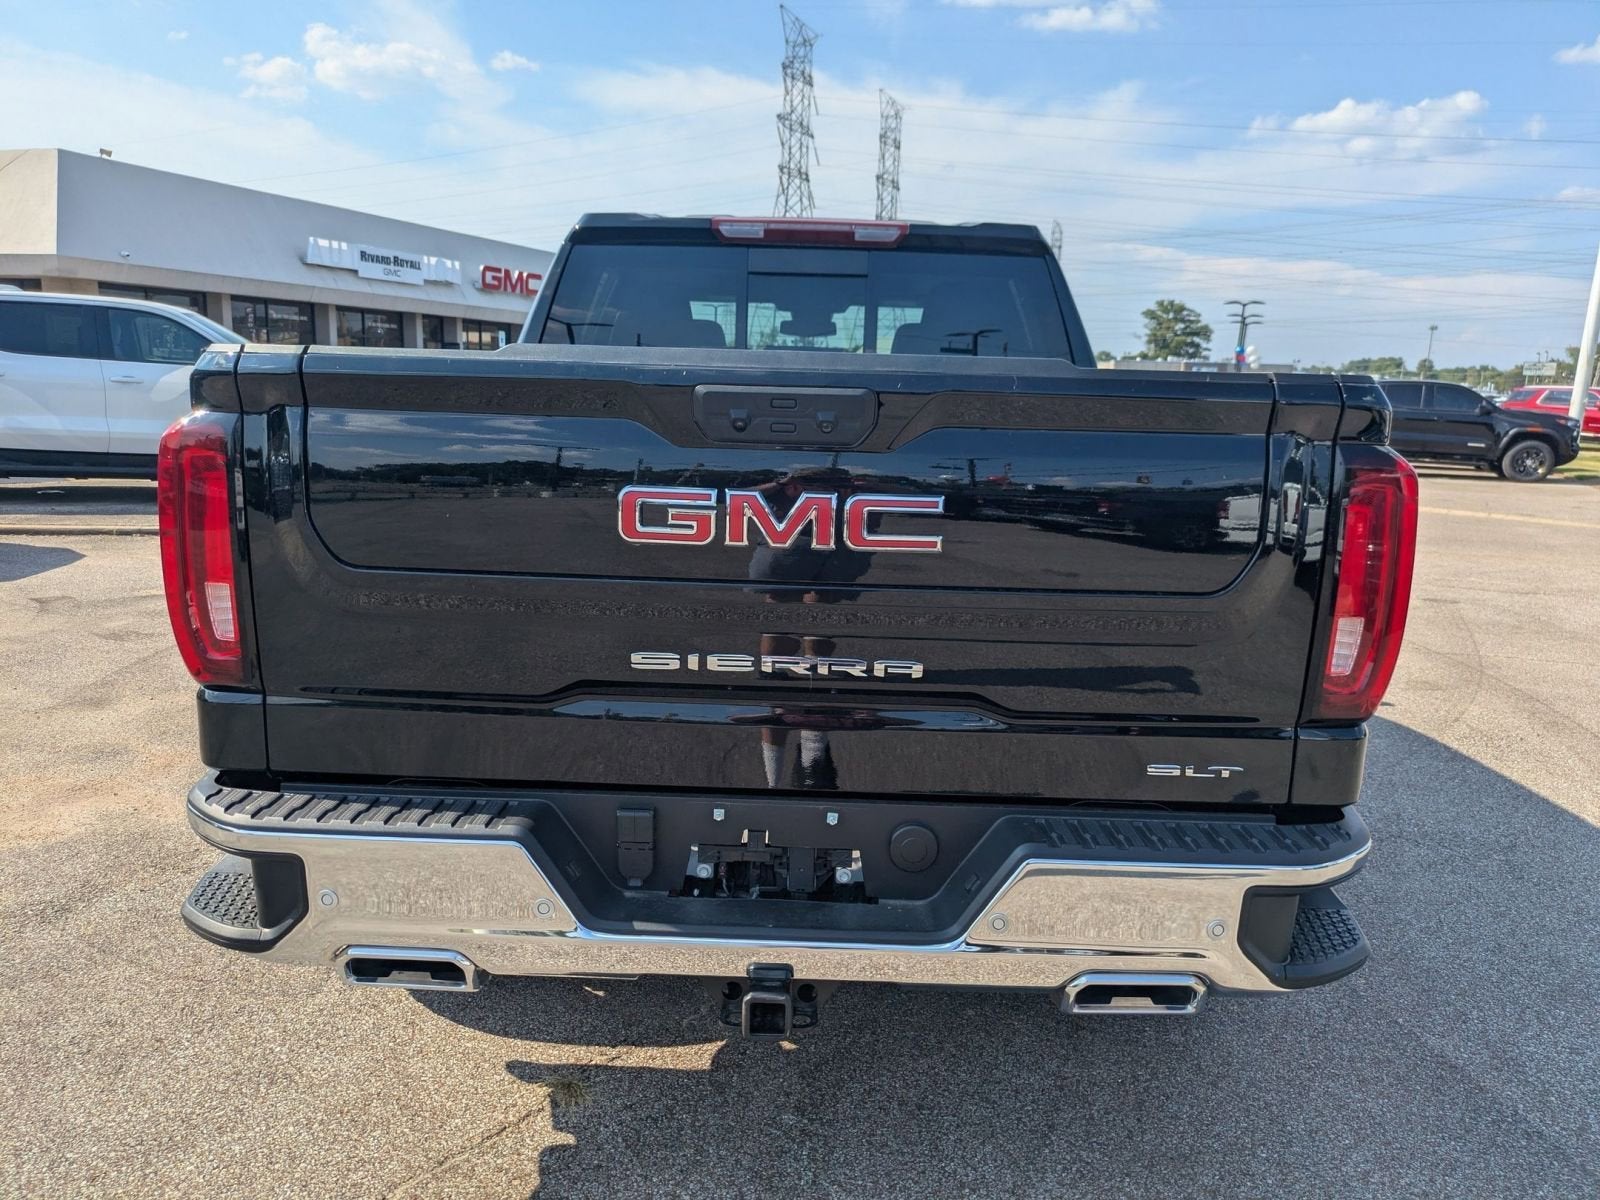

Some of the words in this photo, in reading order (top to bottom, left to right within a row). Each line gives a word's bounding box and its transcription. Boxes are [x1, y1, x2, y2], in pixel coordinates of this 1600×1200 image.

[383, 267, 401, 278] GMC
[481, 265, 543, 297] GMC
[618, 485, 945, 553] GMC
[630, 652, 924, 679] SIERRA
[1146, 764, 1244, 778] SLT
